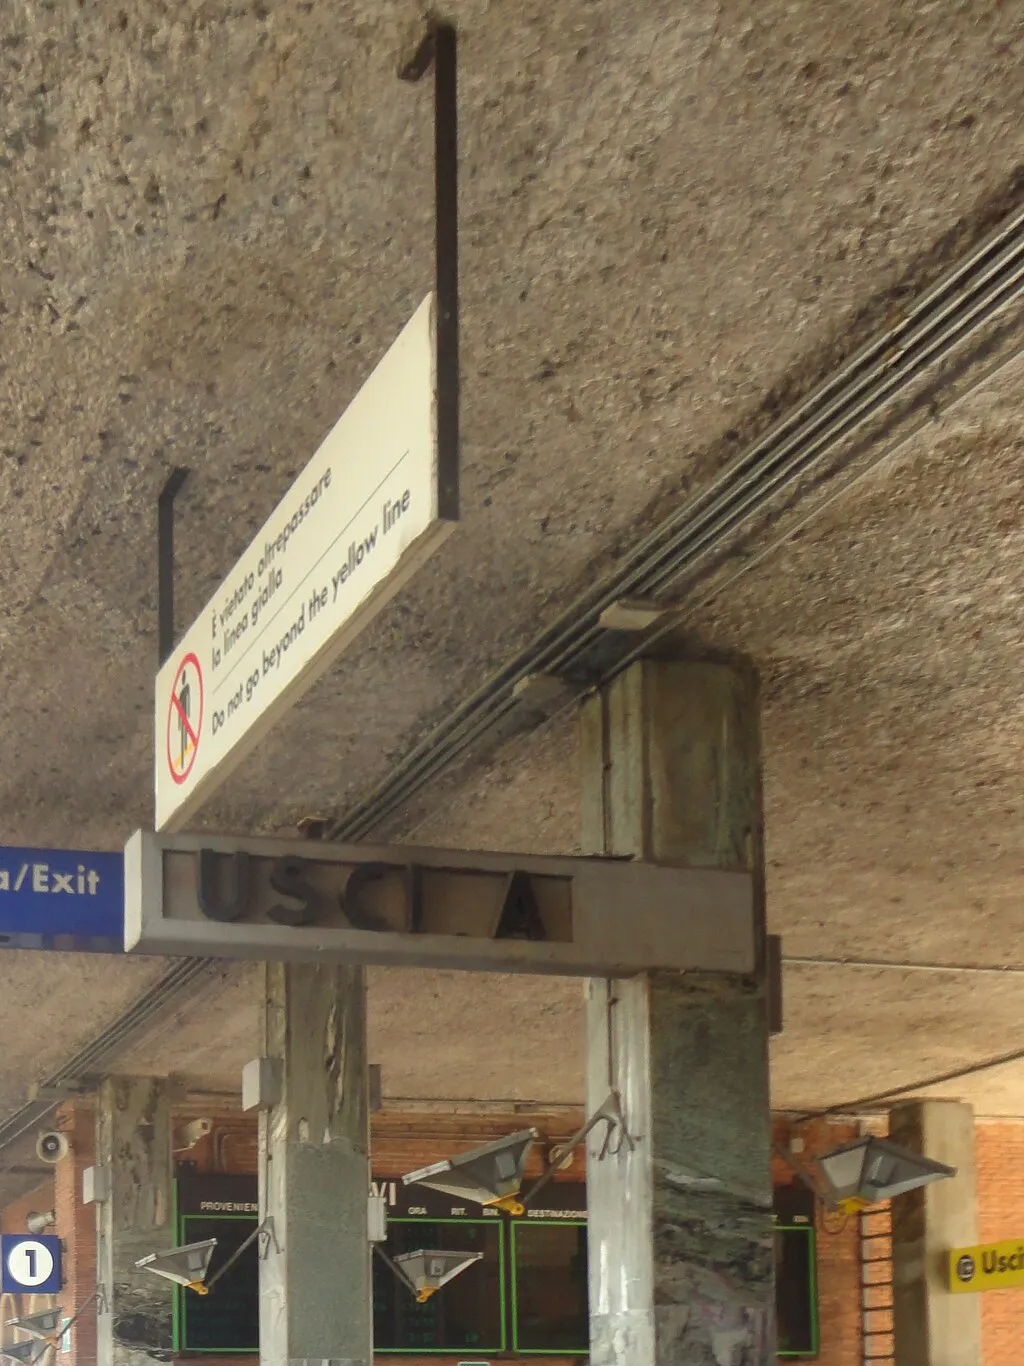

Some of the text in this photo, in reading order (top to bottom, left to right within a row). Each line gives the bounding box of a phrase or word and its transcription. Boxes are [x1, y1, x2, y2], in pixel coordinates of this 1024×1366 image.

[219, 571, 255, 627] vietato
[257, 467, 332, 578] oltrepassare
[211, 488, 411, 736] Do not go beyond the yellow line
[211, 567, 283, 671] la linea gialla
[408, 1206, 428, 1215] ORA
[24, 1250, 37, 1277] 1
